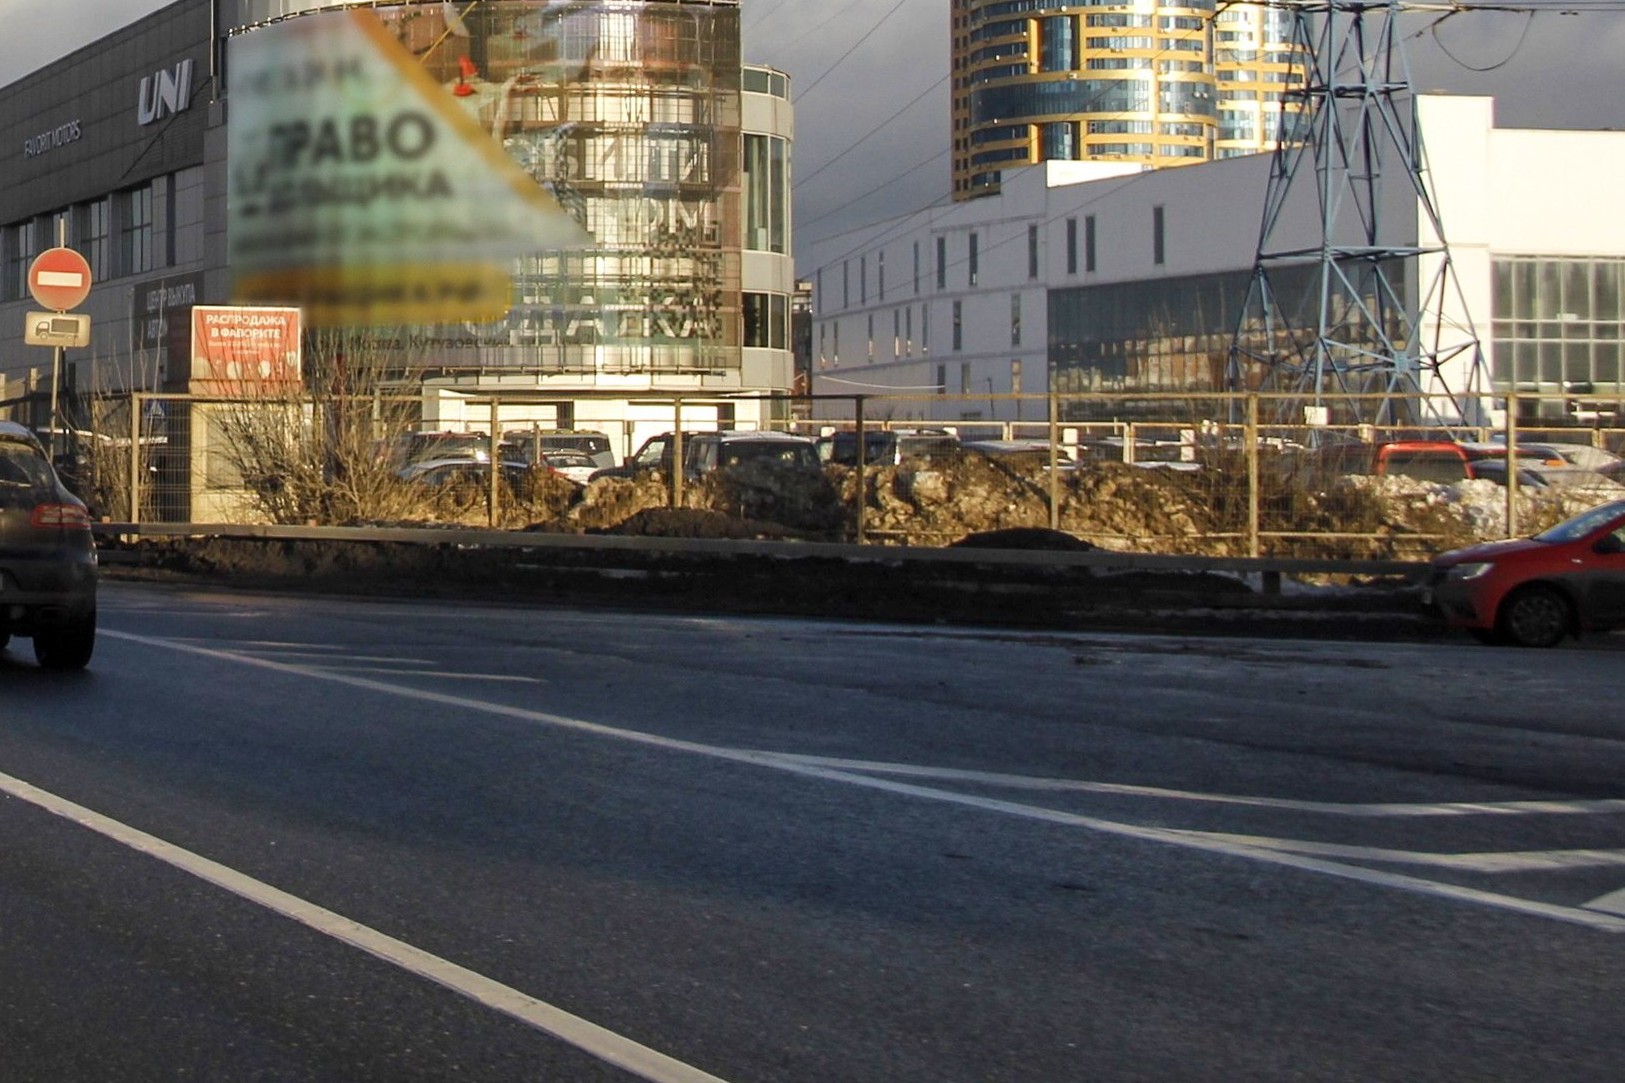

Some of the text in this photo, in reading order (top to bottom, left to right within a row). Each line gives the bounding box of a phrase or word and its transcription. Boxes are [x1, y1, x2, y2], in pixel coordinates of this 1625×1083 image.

[138, 59, 193, 126] UNI
[206, 314, 286, 326] РАСПРОДАЖА
[211, 327, 281, 339] В ФАВОРИТЕ
